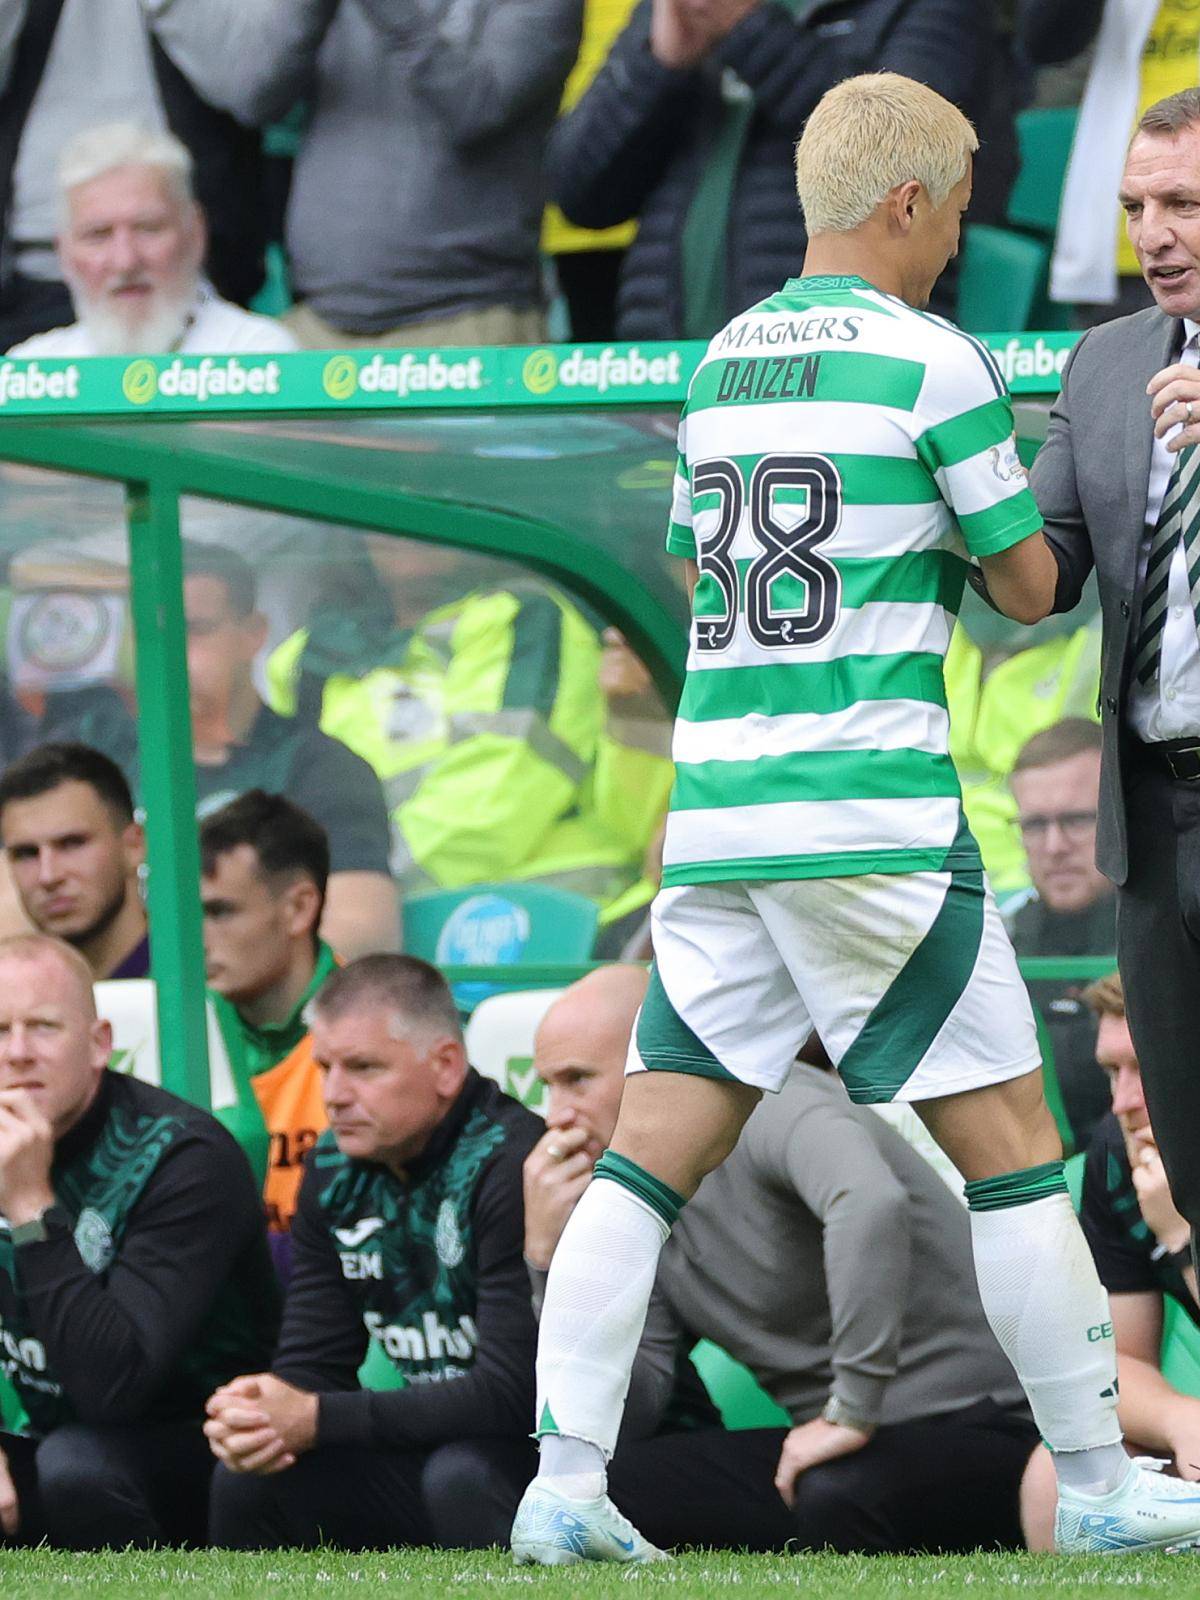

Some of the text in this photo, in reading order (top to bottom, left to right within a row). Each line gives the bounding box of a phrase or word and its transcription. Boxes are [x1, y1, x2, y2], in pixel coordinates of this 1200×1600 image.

[718, 316, 864, 351] MAGNERS
[158, 358, 281, 401] dafabet
[358, 353, 482, 397] dafabet
[559, 347, 681, 393] dafabet
[716, 354, 821, 402] DAIZEN
[693, 452, 842, 654] 38
[339, 1251, 384, 1280] EM
